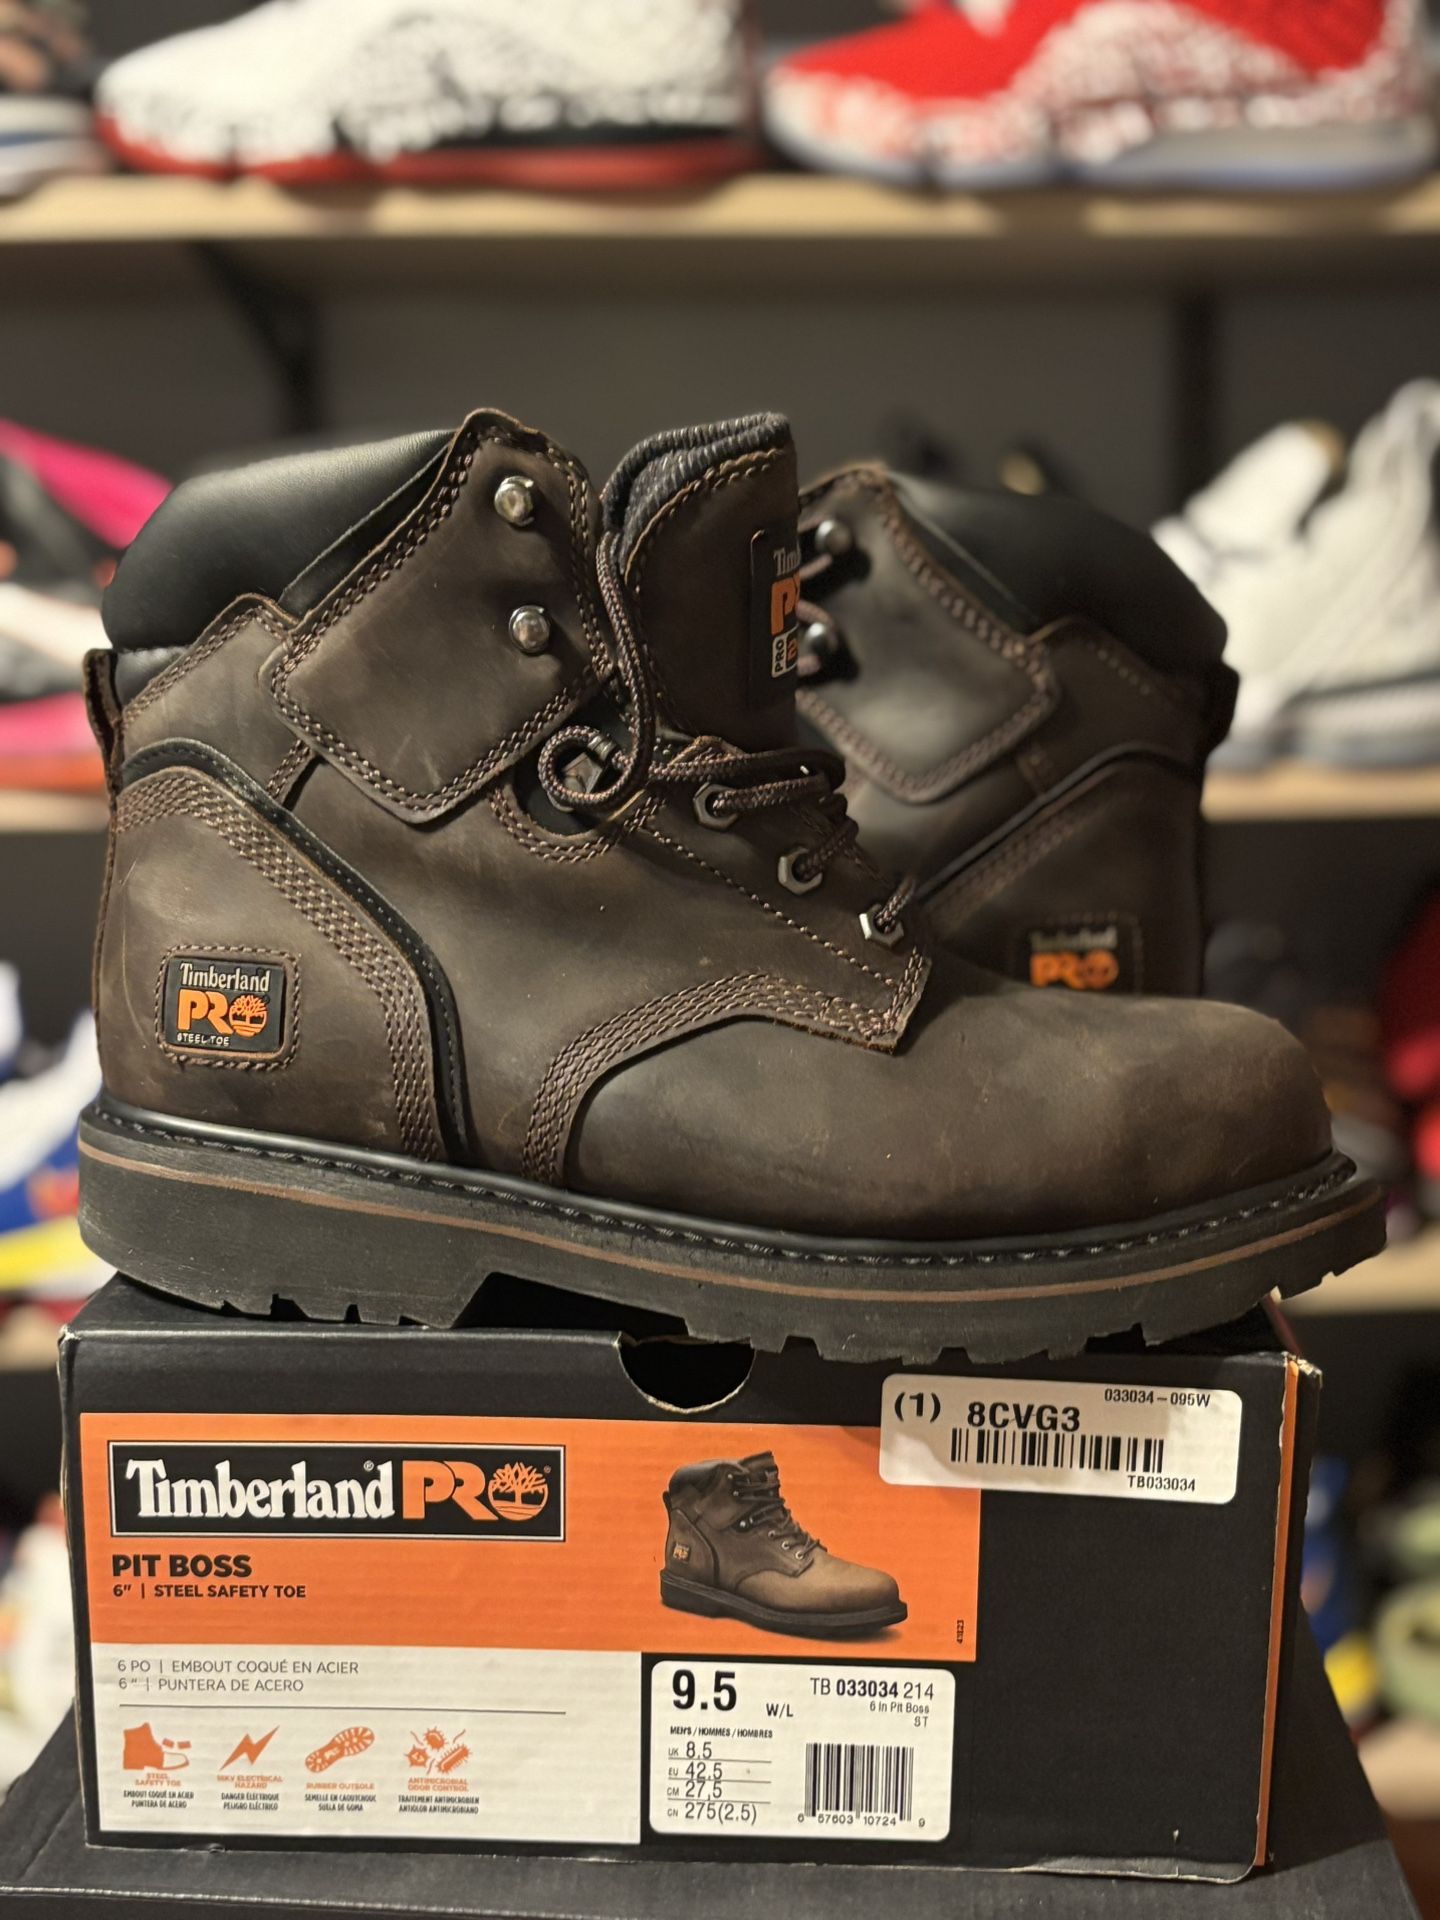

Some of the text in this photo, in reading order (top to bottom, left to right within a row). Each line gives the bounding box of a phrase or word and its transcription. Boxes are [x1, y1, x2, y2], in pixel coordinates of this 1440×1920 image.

[774, 638, 785, 673] PRO
[180, 962, 271, 992] Timberland
[894, 1391, 942, 1423] (1)
[967, 1400, 1081, 1433] 8CVG3
[1127, 1475, 1196, 1493] TB033034
[112, 1554, 252, 1578] PIT BOSS
[154, 1584, 203, 1598] STEEL
[207, 1585, 269, 1598] SAFETY
[273, 1585, 306, 1598] TOE
[118, 1660, 126, 1672] 6
[131, 1660, 151, 1672] PO
[172, 1660, 232, 1673] EMBOUT
[237, 1658, 288, 1674] COQUÉ
[293, 1661, 311, 1673] EN
[316, 1661, 359, 1674] ACIER
[158, 1679, 224, 1691] PUNTERA
[231, 1679, 250, 1691] DE
[254, 1679, 304, 1692] ACERO
[672, 1669, 737, 1711] 9.5
[810, 1677, 934, 1701] TB 033034 214
[766, 1703, 794, 1719] W/L
[869, 1700, 876, 1712] 6
[905, 1702, 929, 1714] Boss
[668, 1748, 679, 1757] UK
[668, 1768, 679, 1776] EU
[667, 1787, 680, 1796] CM
[667, 1808, 679, 1817] CN
[863, 1815, 897, 1826] 10724
